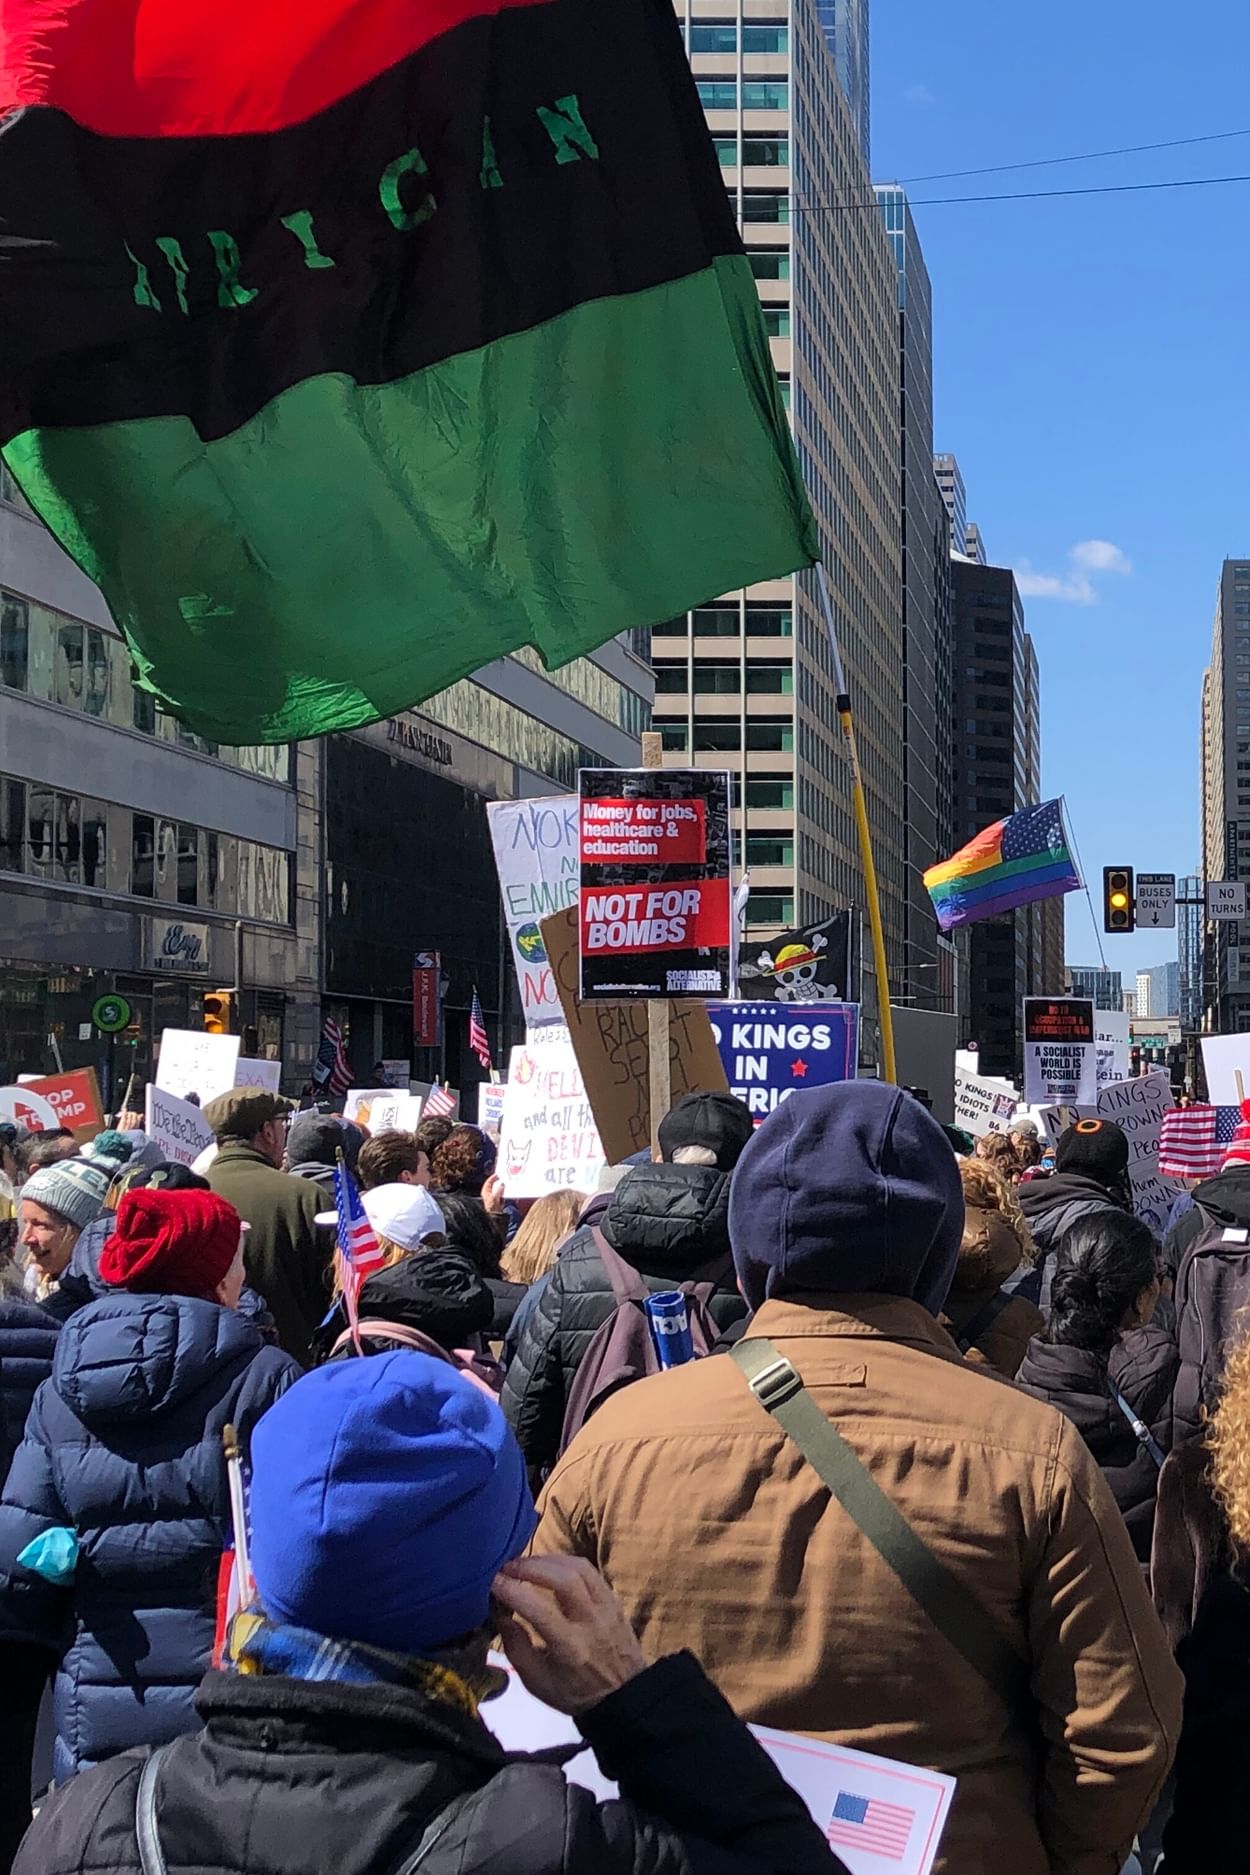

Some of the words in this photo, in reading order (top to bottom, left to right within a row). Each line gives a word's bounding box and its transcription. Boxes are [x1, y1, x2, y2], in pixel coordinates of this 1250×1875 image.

[583, 803, 633, 823] Money
[636, 804, 661, 819] for
[660, 804, 697, 823] jobs,
[583, 822, 663, 838] healthcare
[666, 822, 678, 837] &
[583, 841, 658, 855] education
[1140, 888, 1171, 897] BUSES
[1219, 889, 1234, 898] NO
[585, 893, 643, 922] NOT
[646, 889, 701, 918] FOR
[1142, 900, 1168, 909] ONLY
[1211, 904, 1244, 913] TURNS
[588, 917, 686, 949] BOMBS
[666, 979, 722, 992] ALTERNATIVE
[731, 1024, 831, 1050] KINGS
[1035, 1046, 1041, 1056] A
[1043, 1046, 1085, 1057] SOCIALIST
[735, 1056, 768, 1081] IN
[1041, 1058, 1070, 1068] WORLD
[1073, 1058, 1081, 1068] IS
[1041, 1070, 1080, 1080] POSSIBLE
[965, 1083, 997, 1102] KINGS!
[960, 1094, 990, 1113] IDIOTS
[524, 1105, 548, 1130] and
